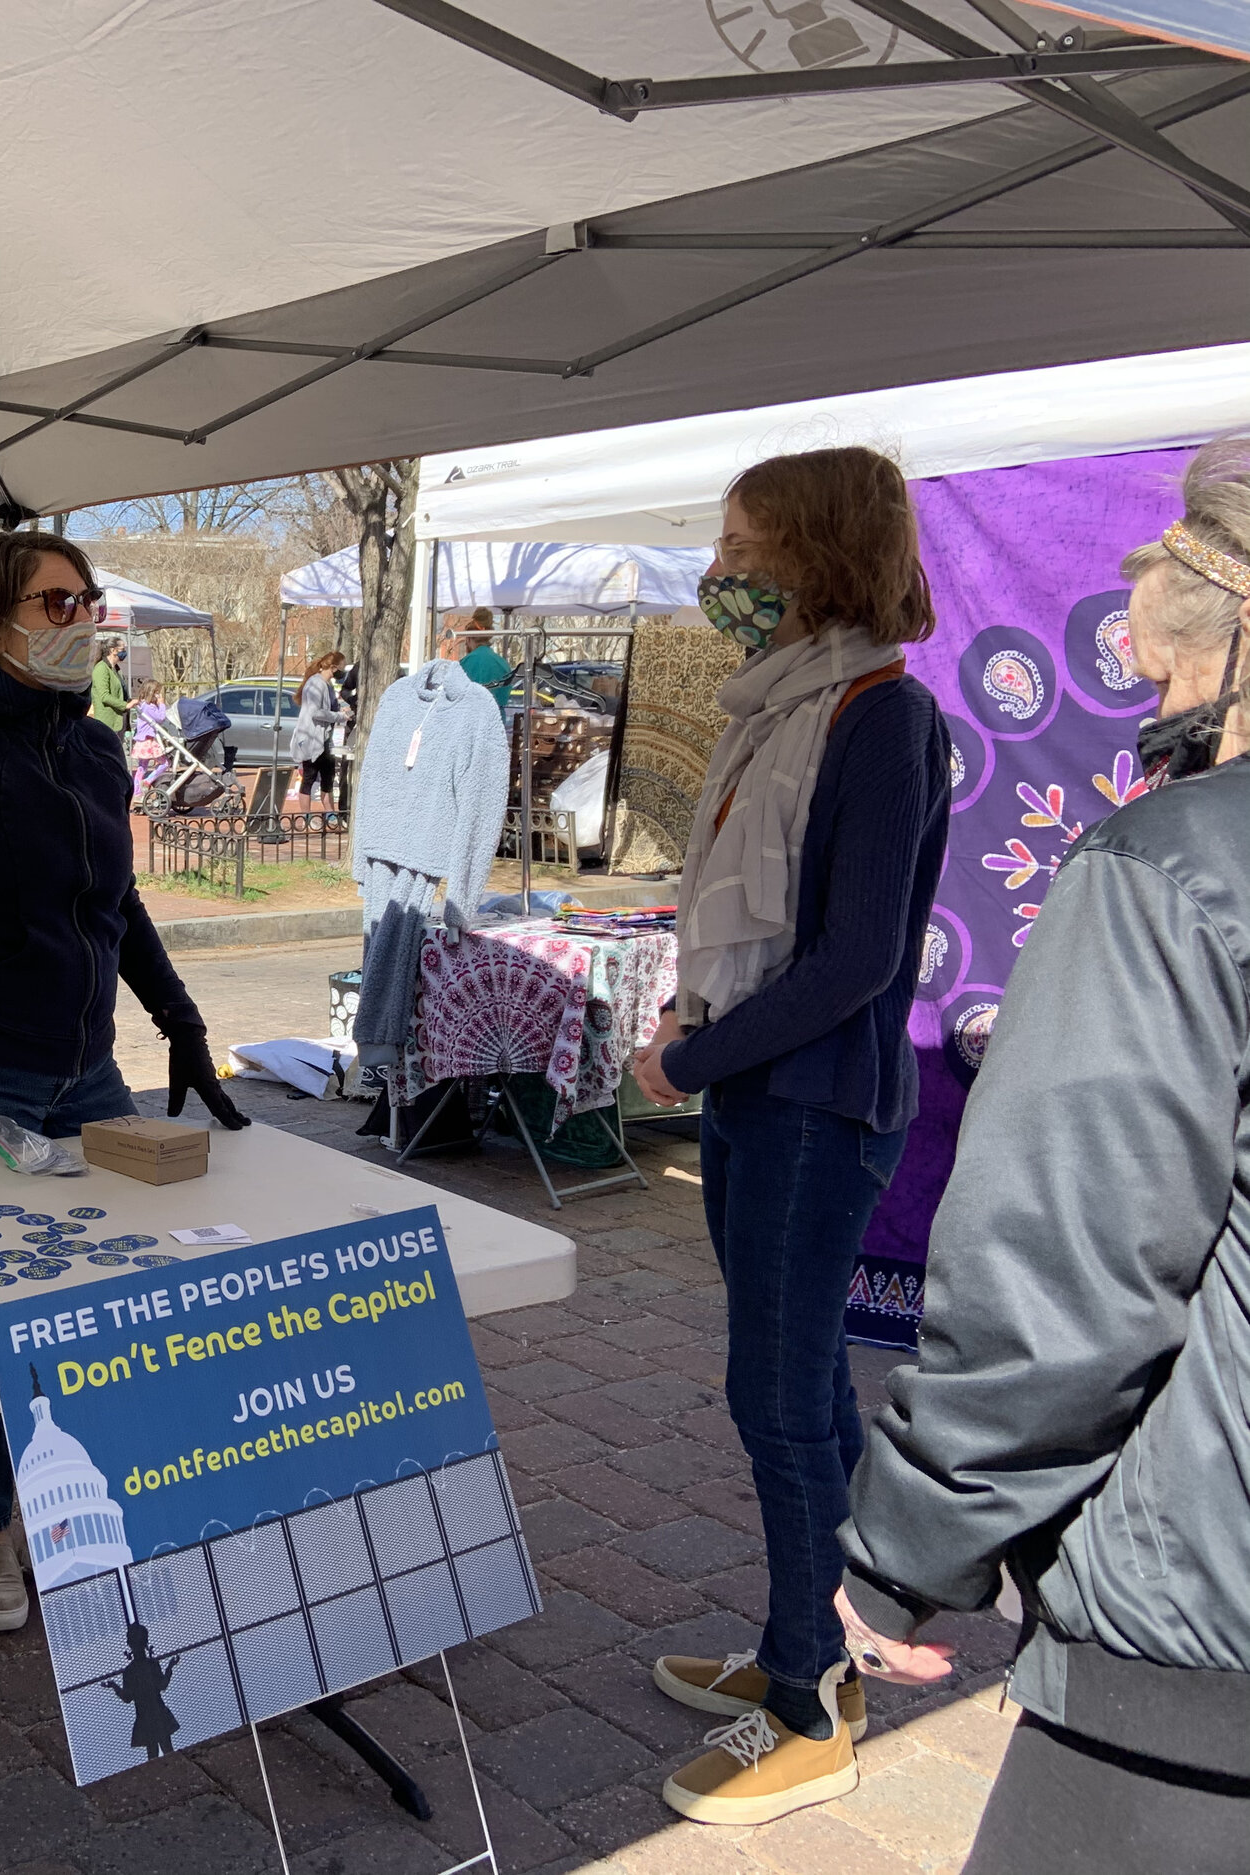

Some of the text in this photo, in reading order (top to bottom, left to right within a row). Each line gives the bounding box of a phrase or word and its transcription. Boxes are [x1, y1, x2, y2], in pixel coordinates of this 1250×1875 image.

[9, 1227, 439, 1354] FREE THE PEOPLE'S HOUSE
[57, 1270, 437, 1395] Don't Fence the Capitol
[124, 1380, 466, 1496] dontfencethecapitol.com
[232, 1364, 356, 1423] JOIN US
